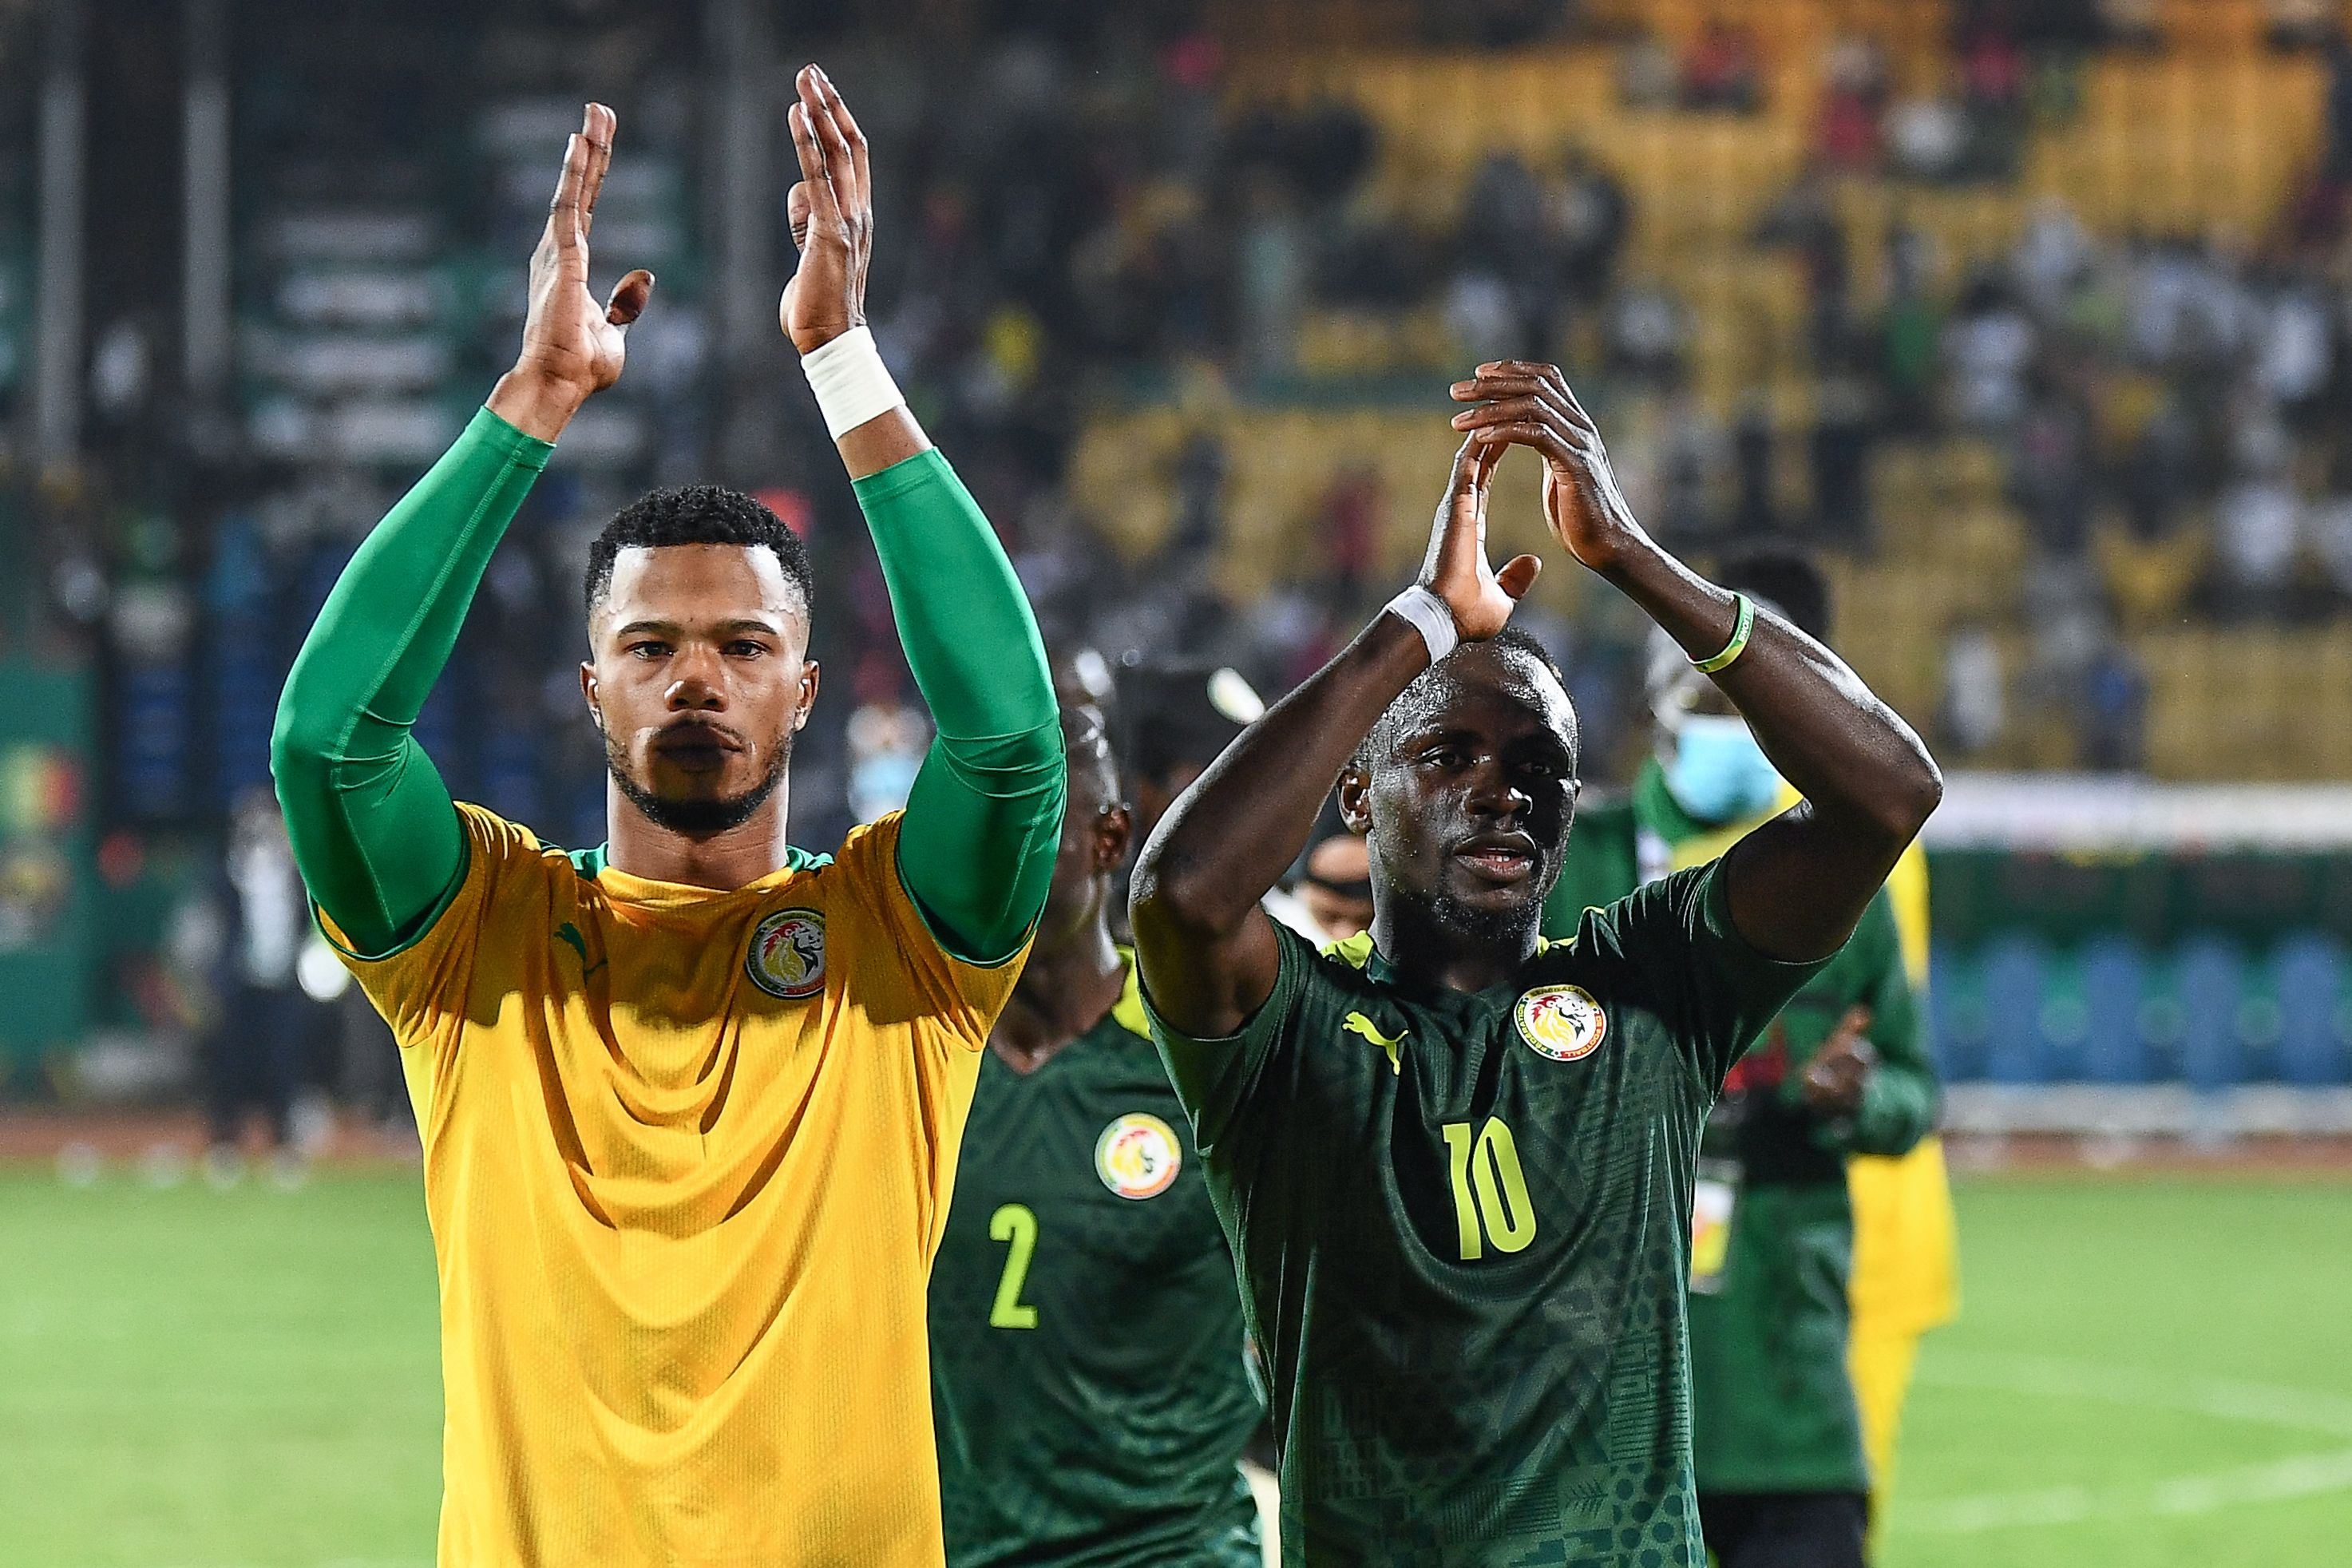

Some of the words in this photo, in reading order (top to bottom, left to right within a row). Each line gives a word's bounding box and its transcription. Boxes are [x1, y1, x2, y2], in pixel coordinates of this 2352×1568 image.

[1565, 1028, 1602, 1057] FOOTBALL
[1442, 1116, 1537, 1260] 10
[988, 1202, 1039, 1328] 2
